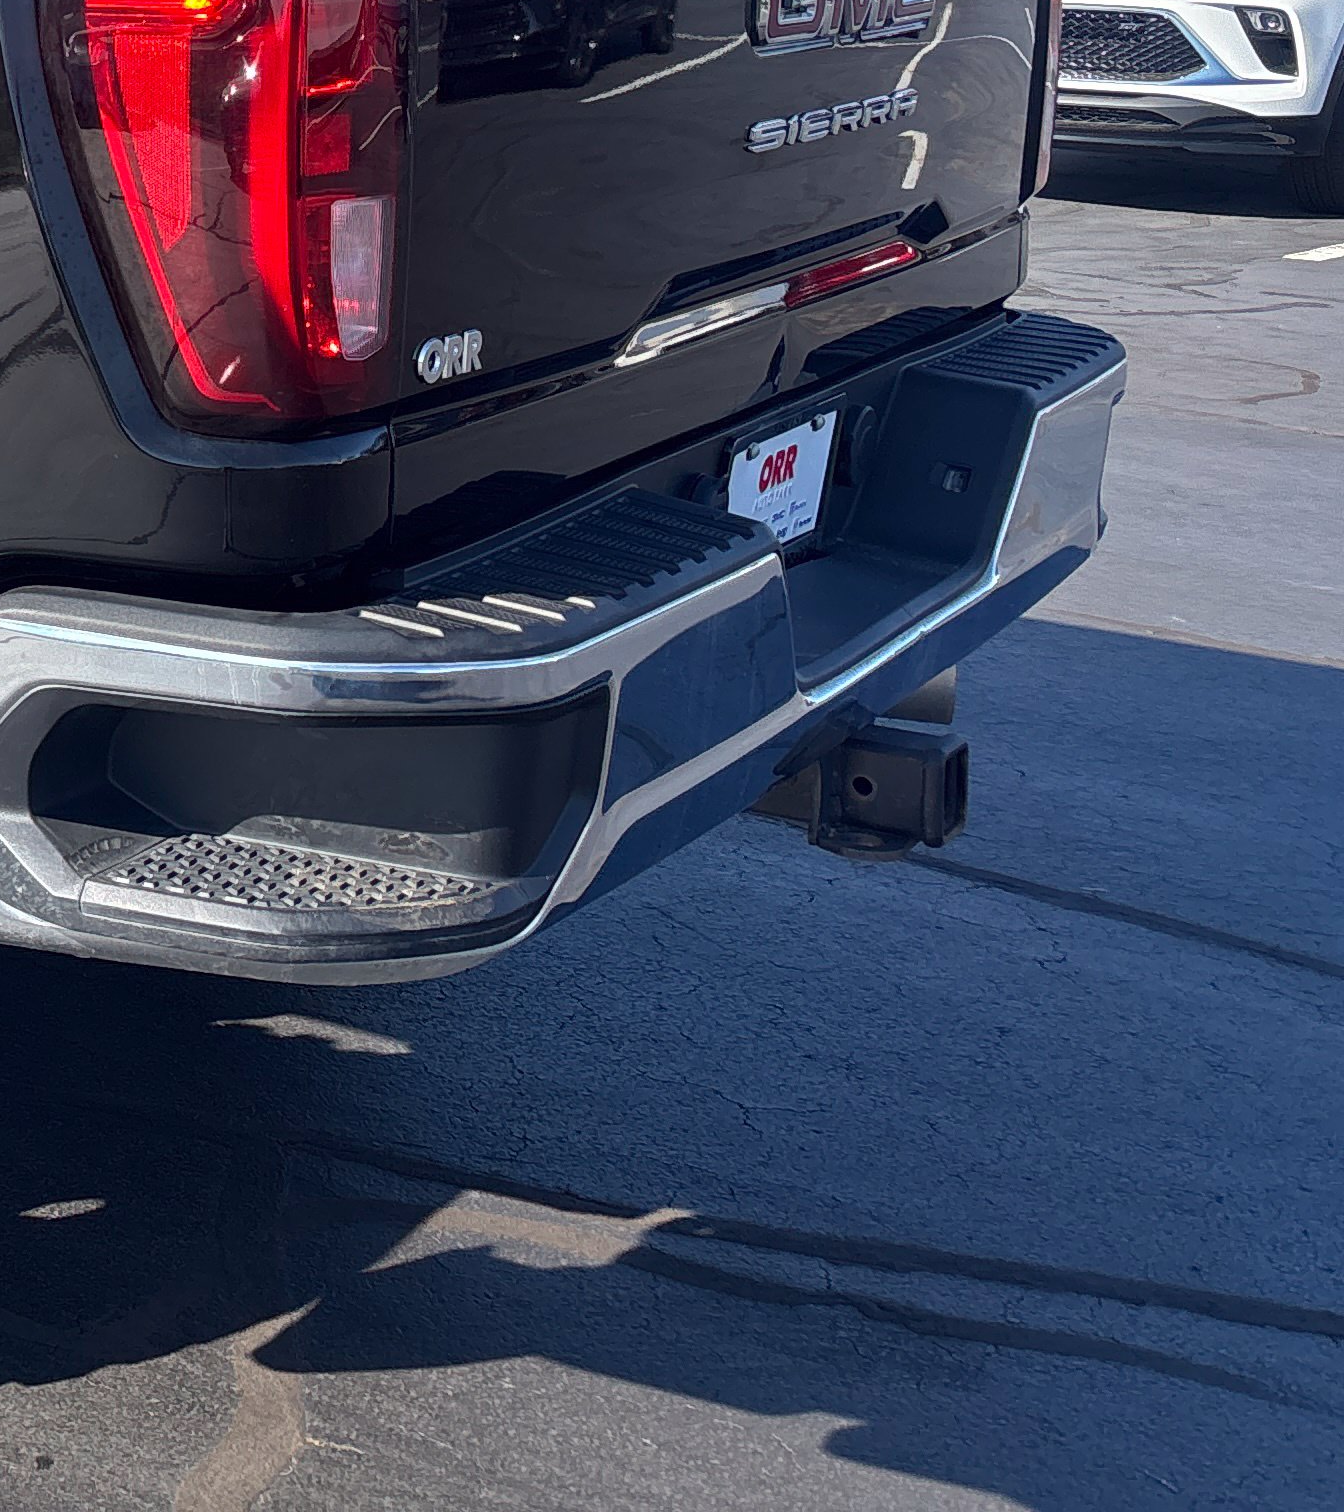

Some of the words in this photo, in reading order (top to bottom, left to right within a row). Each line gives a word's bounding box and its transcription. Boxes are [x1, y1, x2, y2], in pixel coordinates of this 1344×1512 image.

[745, 88, 920, 153] SIERRA
[416, 329, 483, 385] ORR
[758, 444, 799, 494] ORR
